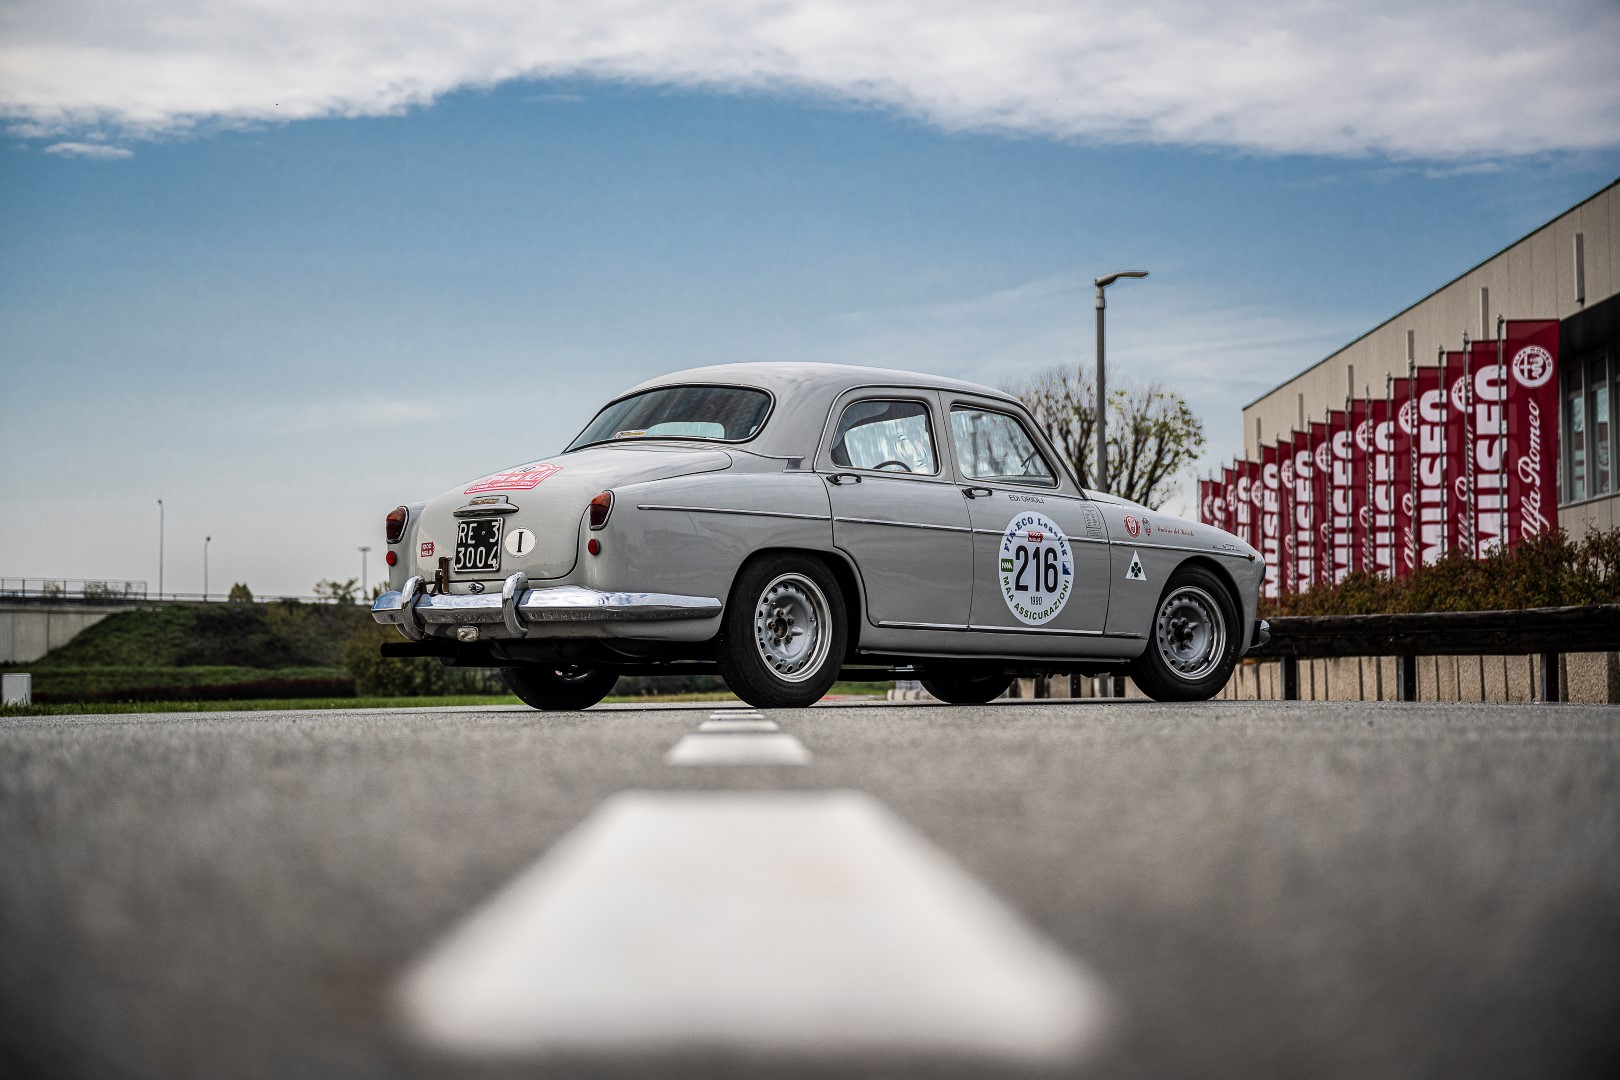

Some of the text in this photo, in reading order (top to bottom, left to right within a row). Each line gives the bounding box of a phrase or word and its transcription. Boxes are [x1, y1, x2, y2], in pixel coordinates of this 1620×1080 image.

[1517, 397, 1550, 543] Alfa Romeo
[458, 522, 500, 544] RE 3
[516, 531, 524, 553] I
[1037, 517, 1068, 557] Leasing
[456, 546, 498, 568] 3004
[1014, 545, 1059, 593] 216
[1003, 575, 1070, 620] MAA ASSICURAZIONI
